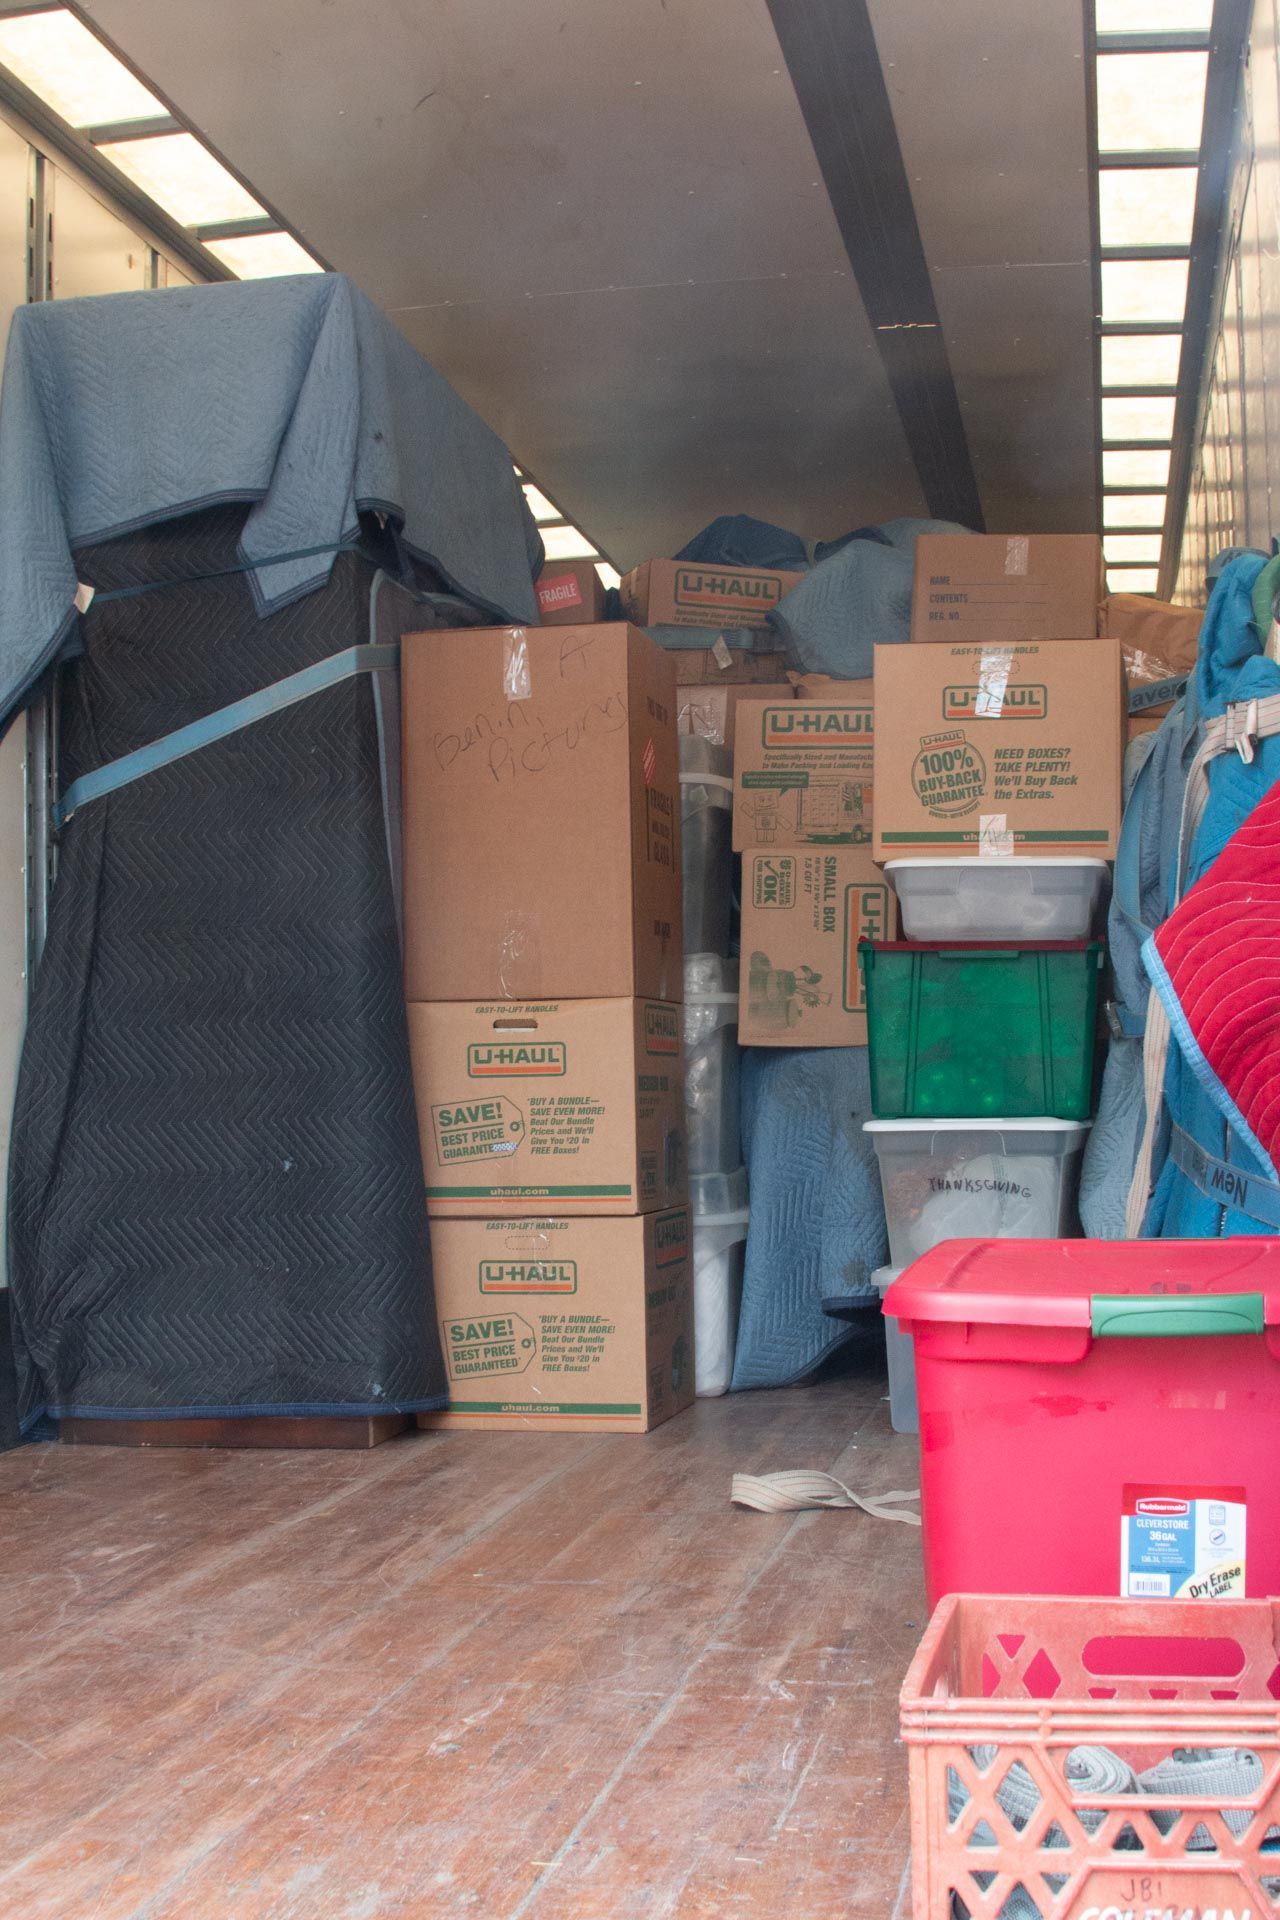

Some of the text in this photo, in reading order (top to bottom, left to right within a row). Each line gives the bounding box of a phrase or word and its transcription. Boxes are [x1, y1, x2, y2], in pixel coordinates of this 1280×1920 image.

[930, 576, 951, 585] NAME
[682, 575, 774, 599] U-HAUL
[539, 583, 577, 604] FRAGILE
[929, 593, 968, 603] CONTENTS
[771, 714, 874, 733] U-HAUL
[922, 733, 962, 746] U-HAUL
[994, 748, 1071, 760] NEED BOXES?
[920, 748, 974, 776] 100%
[994, 761, 1071, 772] TAKE PLENTY!
[918, 769, 982, 792] BUY-BACK
[994, 774, 1078, 788] We'll Buy Back
[920, 784, 984, 806] GUARANTEE
[994, 789, 1054, 800] the Extras.
[764, 875, 778, 904] OK
[822, 856, 836, 932] SMALL BOX
[475, 1004, 558, 1014] EASY-TO-LIFT HANDLES
[474, 1048, 560, 1064] U-HAUL
[548, 1097, 554, 1106] A
[438, 1102, 502, 1126] SAVE!
[530, 1106, 606, 1116] SAVE EVEN MORE!
[530, 1118, 548, 1126] Beat
[566, 1116, 594, 1125] Bundle
[574, 1126, 594, 1134] We'll
[441, 1128, 504, 1146] BEST PRICE
[530, 1137, 548, 1145] Give
[582, 1136, 590, 1144] in
[530, 1146, 580, 1154] FREE Boxes!
[490, 1188, 549, 1196] uhaul.com
[928, 1178, 1032, 1198] THANKSGIVING
[1211, 1167, 1248, 1208] New
[486, 1222, 568, 1230] EASY-TO-LIFT HANDLES
[486, 1266, 571, 1281] U-HAUL
[450, 1319, 514, 1342] SAVE!
[542, 1326, 616, 1334] SAVE EVEN MORE!
[542, 1336, 559, 1344] Beat
[452, 1344, 516, 1362] BEST PRICE
[542, 1354, 558, 1362] Give
[562, 1354, 574, 1362] You
[592, 1354, 600, 1362] in
[542, 1364, 590, 1372] FREE Boxes!
[502, 1404, 560, 1412] uhaul.com
[1140, 1503, 1186, 1511] Rubbermaid
[1136, 1518, 1190, 1530] CLEVERSTORE
[1190, 1580, 1208, 1598] Dry
[1210, 1566, 1241, 1586] Erase
[1210, 1582, 1232, 1598] LABEL
